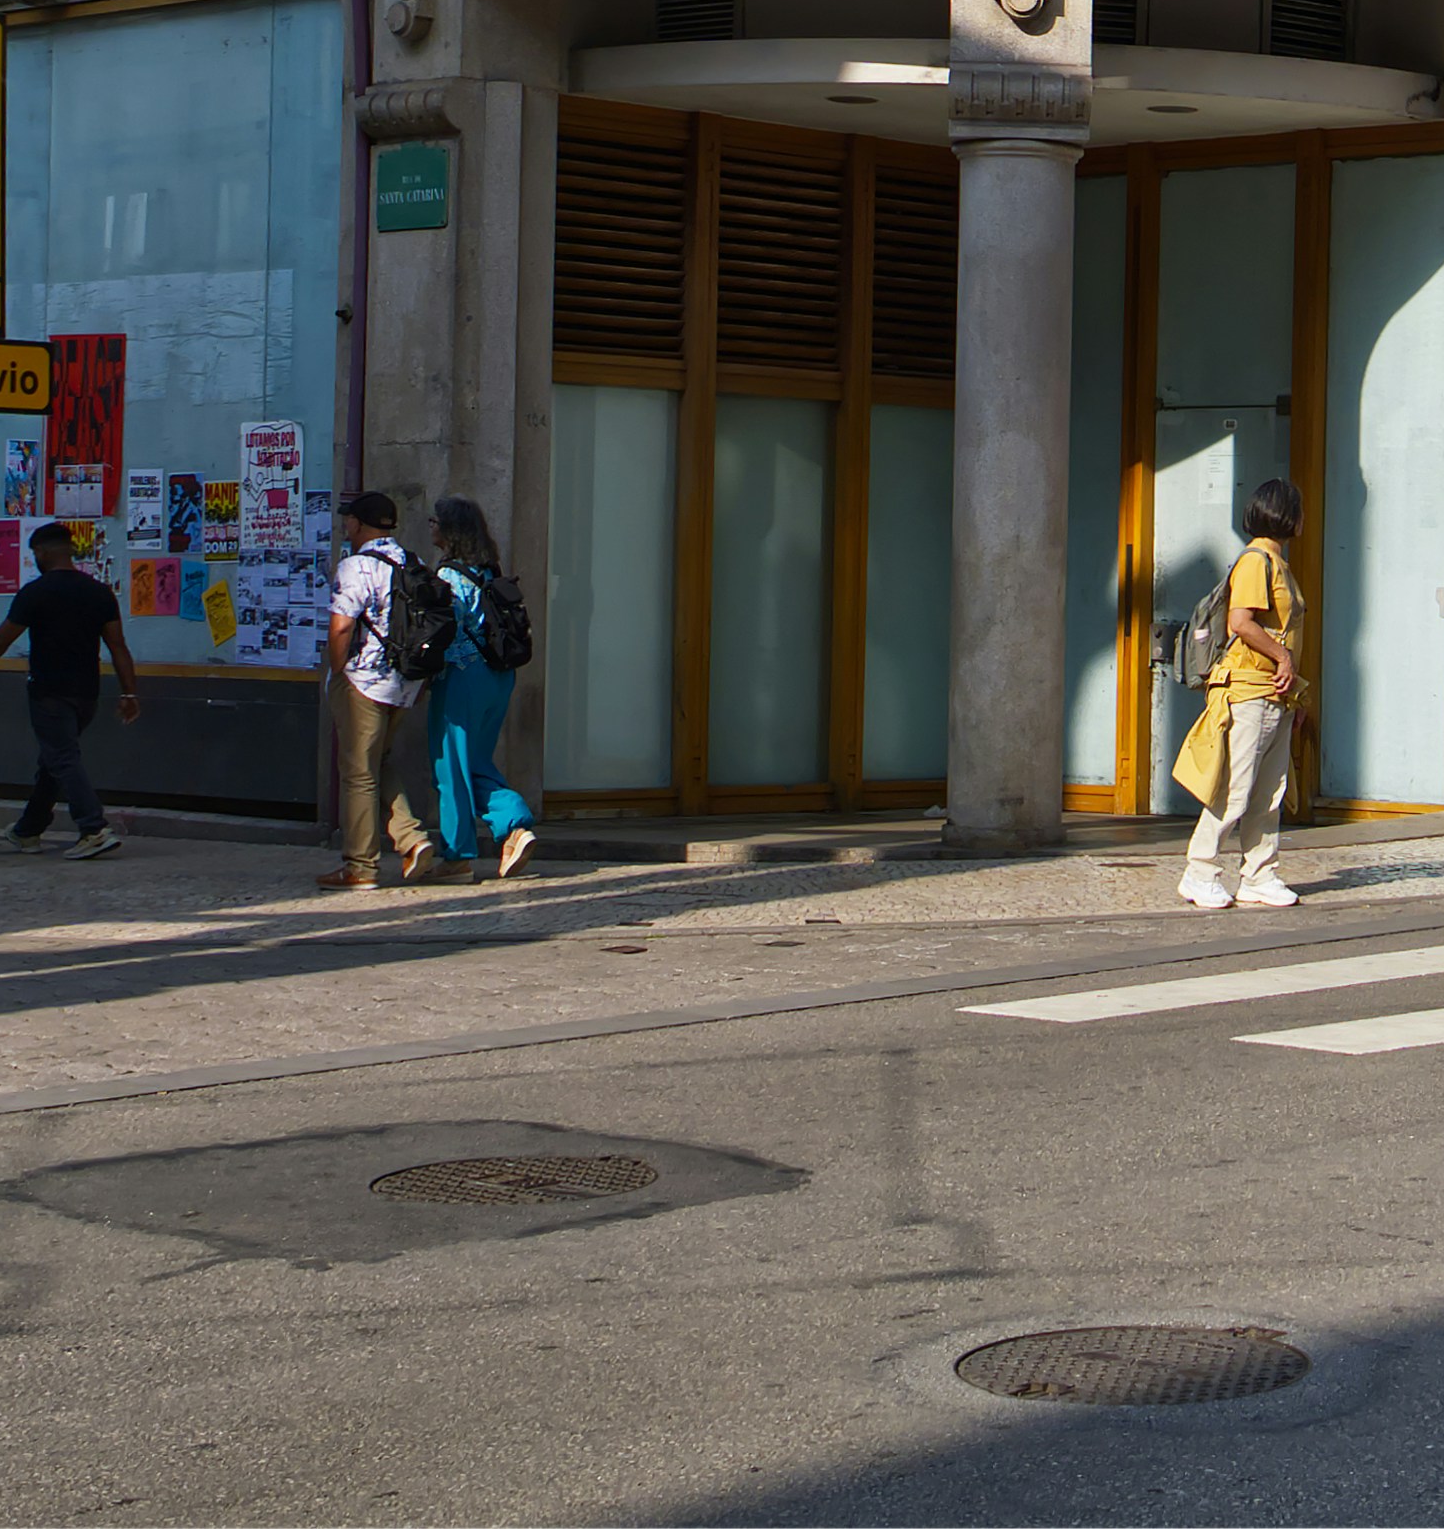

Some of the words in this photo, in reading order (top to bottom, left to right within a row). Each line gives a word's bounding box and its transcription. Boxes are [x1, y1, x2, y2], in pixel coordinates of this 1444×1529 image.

[379, 192, 404, 204] SANTA
[406, 188, 444, 202] CATARINA
[205, 483, 239, 507] MANIF
[205, 542, 227, 554] DOM
